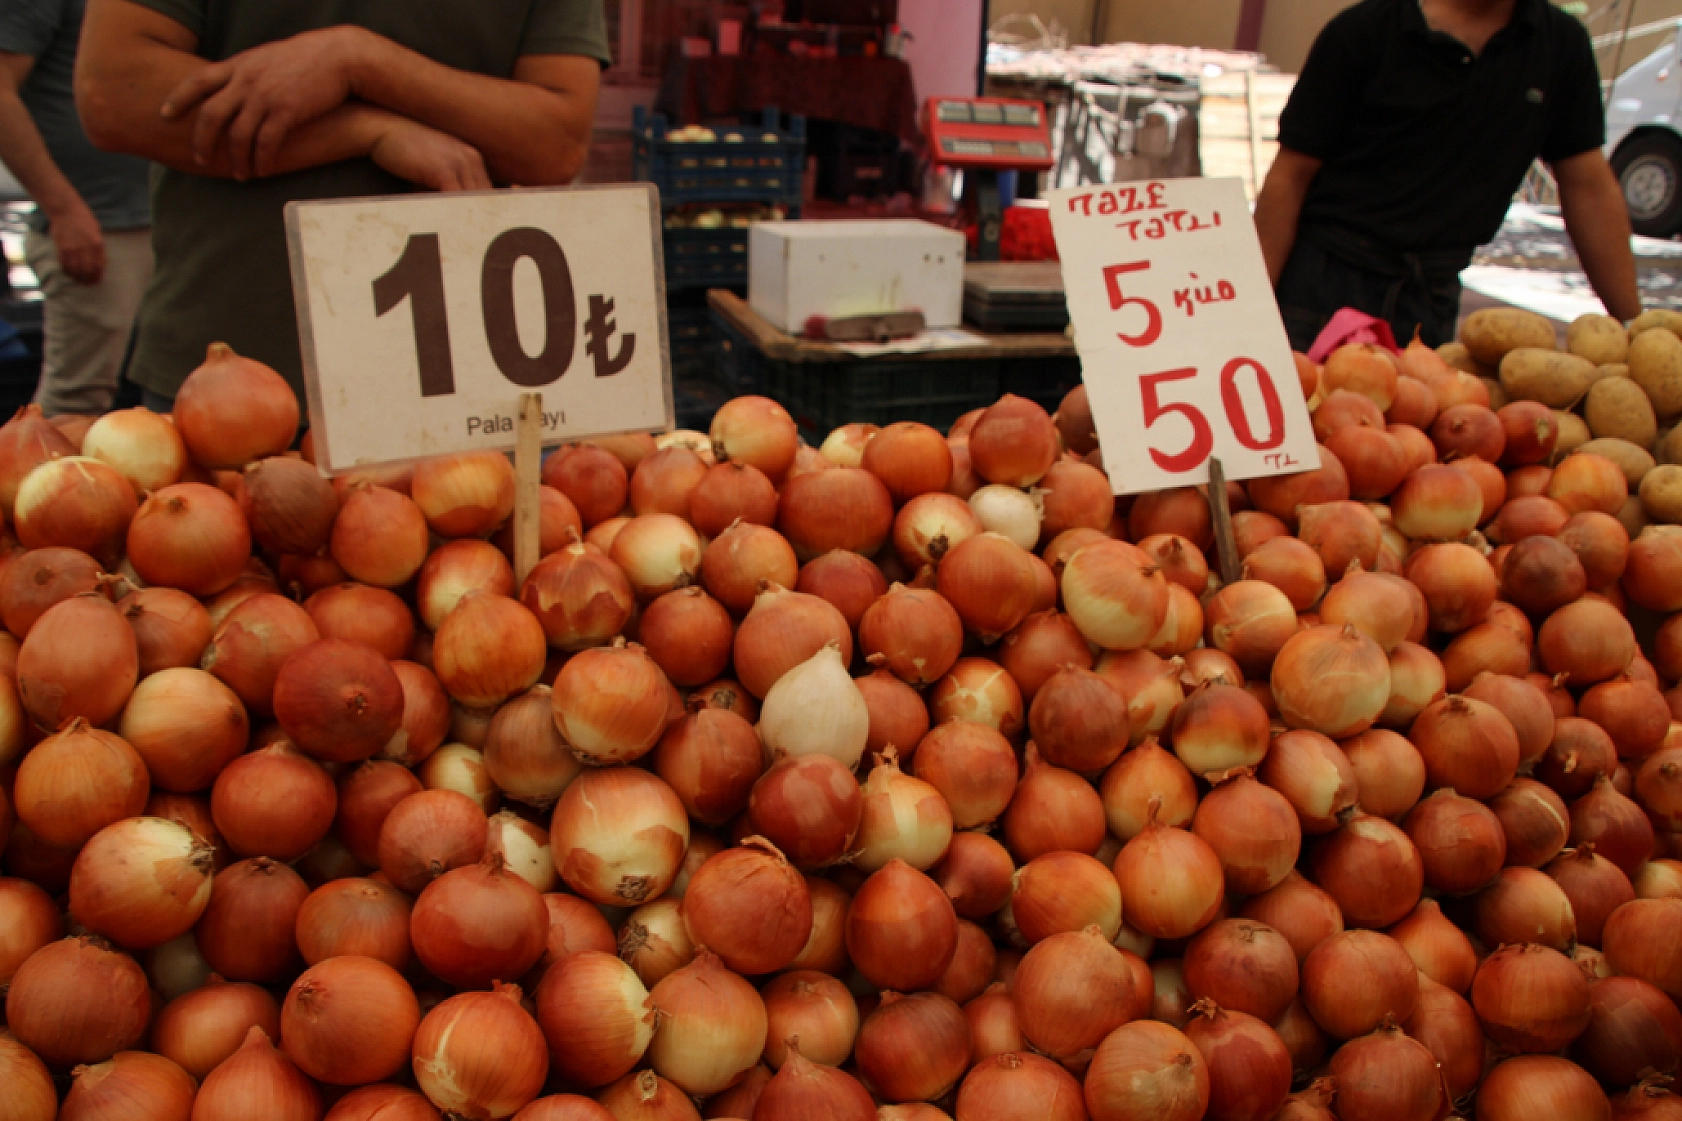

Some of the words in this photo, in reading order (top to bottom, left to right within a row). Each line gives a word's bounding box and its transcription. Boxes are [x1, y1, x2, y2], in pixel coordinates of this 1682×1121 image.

[1102, 259, 1163, 348] 5
[466, 413, 514, 436] Pala
[1138, 356, 1286, 473] 50
